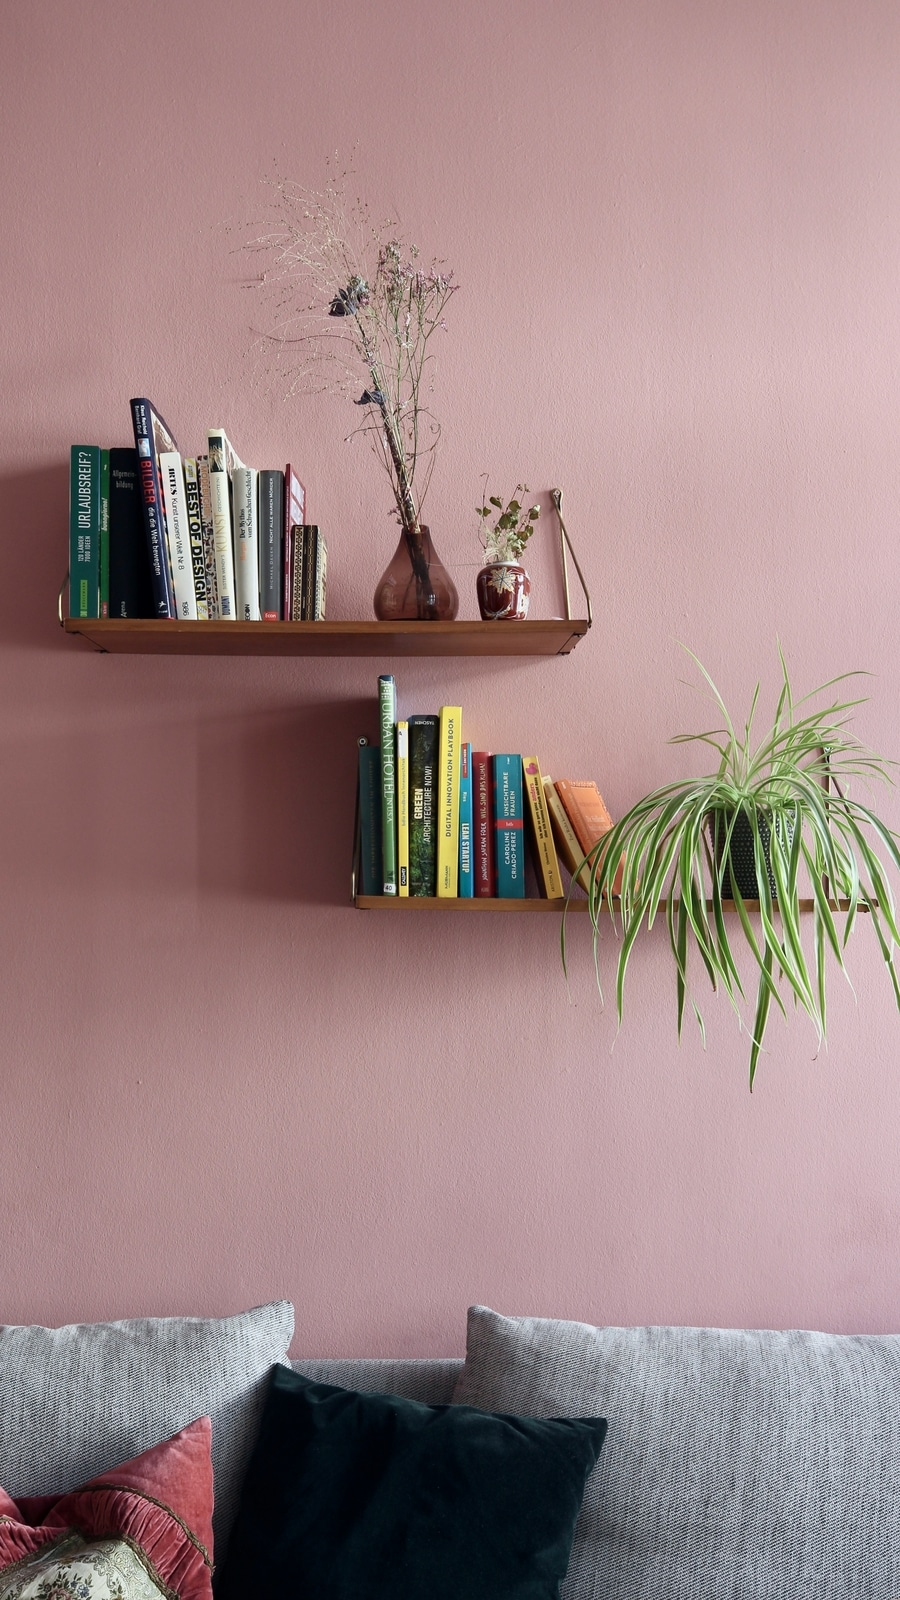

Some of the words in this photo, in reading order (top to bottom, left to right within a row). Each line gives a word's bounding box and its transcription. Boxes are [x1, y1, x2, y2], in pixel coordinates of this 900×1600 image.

[78, 452, 92, 529] URLAUBSREIF?
[140, 460, 156, 505] BILDER
[187, 482, 200, 520] BEST
[171, 498, 179, 514] Kunst
[150, 530, 159, 544] Welt
[189, 522, 202, 541] OF
[214, 513, 227, 552] KUNST
[150, 545, 161, 576] bewegten
[192, 546, 206, 602] DESIGN
[221, 595, 230, 615] DUMONT
[382, 702, 394, 750] URBAN
[383, 754, 394, 798] HOTEL
[414, 788, 423, 819] GREEN
[424, 787, 432, 843] ARCHITECTURE
[462, 823, 470, 840] LEAN
